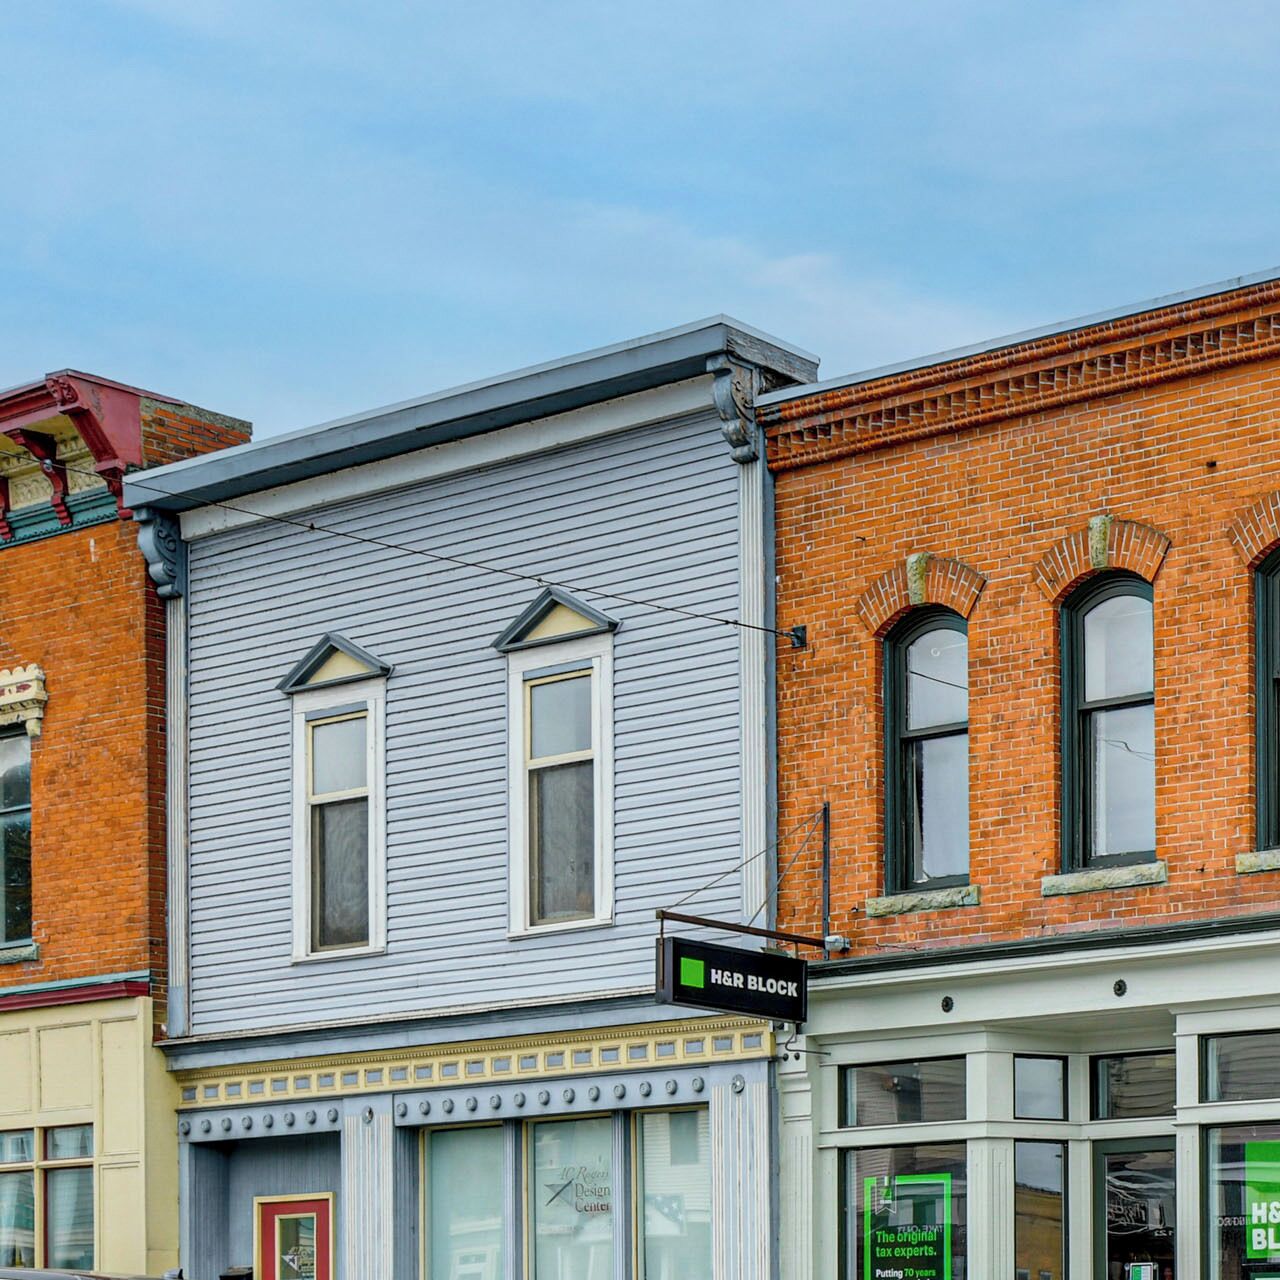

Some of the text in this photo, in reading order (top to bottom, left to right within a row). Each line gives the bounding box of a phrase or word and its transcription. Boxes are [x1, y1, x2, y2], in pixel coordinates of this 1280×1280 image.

[710, 968, 798, 998] H&R BLOCK
[575, 1182, 611, 1199] Design
[575, 1198, 609, 1213] Center
[875, 1229, 937, 1245] The original
[875, 1244, 937, 1259] tax experts.
[876, 1268, 937, 1280] Putting 70 years
